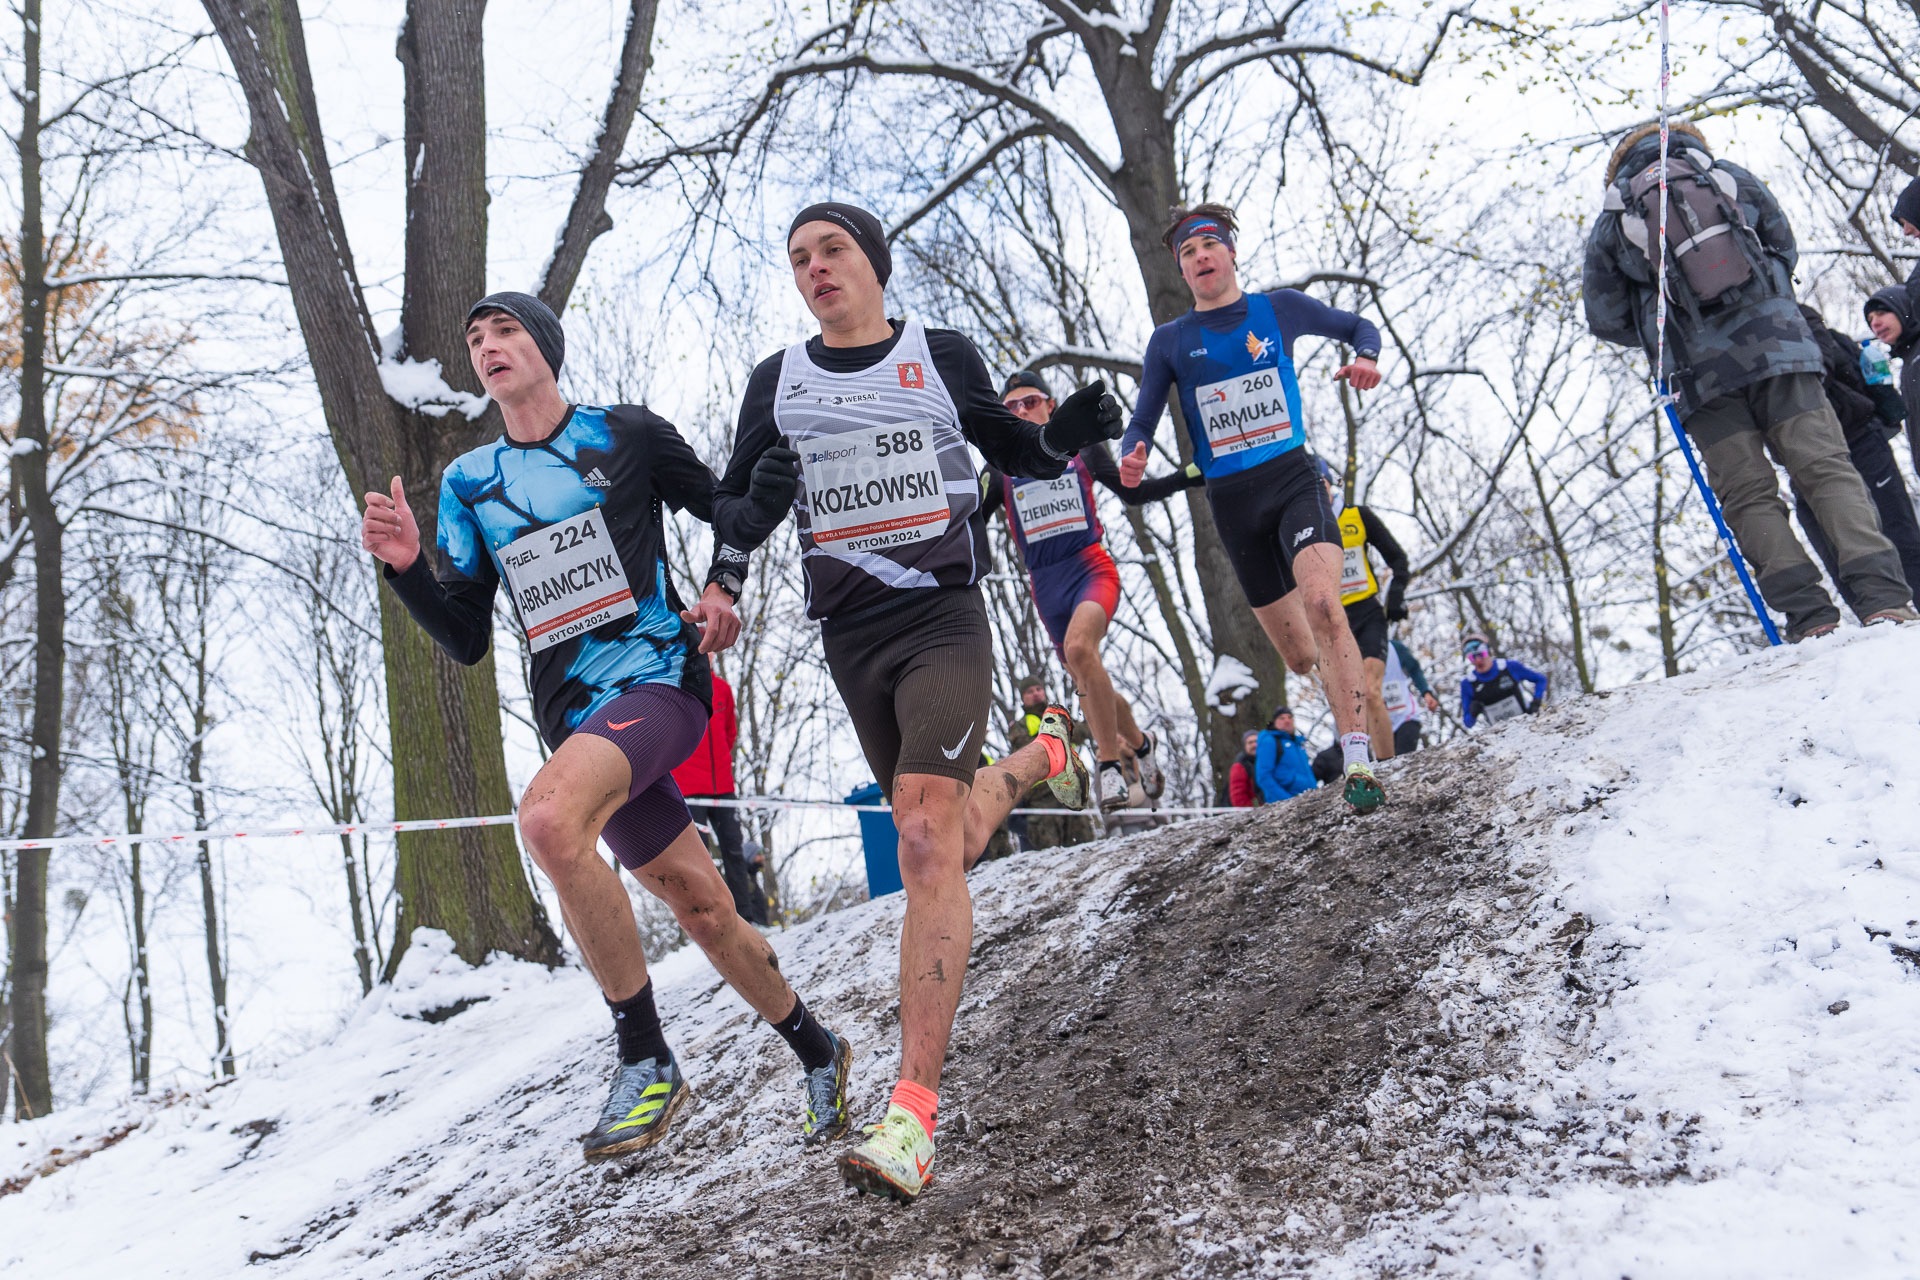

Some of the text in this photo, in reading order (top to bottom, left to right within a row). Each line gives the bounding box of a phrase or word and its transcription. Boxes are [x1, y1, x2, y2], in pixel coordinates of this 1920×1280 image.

[786, 389, 808, 400] erima
[1242, 374, 1273, 394] 260
[845, 393, 877, 403] WERSAL
[1209, 398, 1284, 432] ARMUŁA
[875, 429, 923, 457] 588
[1230, 440, 1256, 452] BYTOM
[580, 480, 611, 488] adidas
[811, 470, 939, 516] KOZŁOWSKI
[1050, 478, 1073, 492] 451
[1021, 498, 1080, 523] ZIELIŃSKI
[550, 519, 597, 554] 224
[847, 529, 921, 551] BYTOM 2024
[518, 554, 620, 615] ABRAMCZYK
[548, 622, 585, 643] BYTOM
[584, 611, 611, 628] 2024
